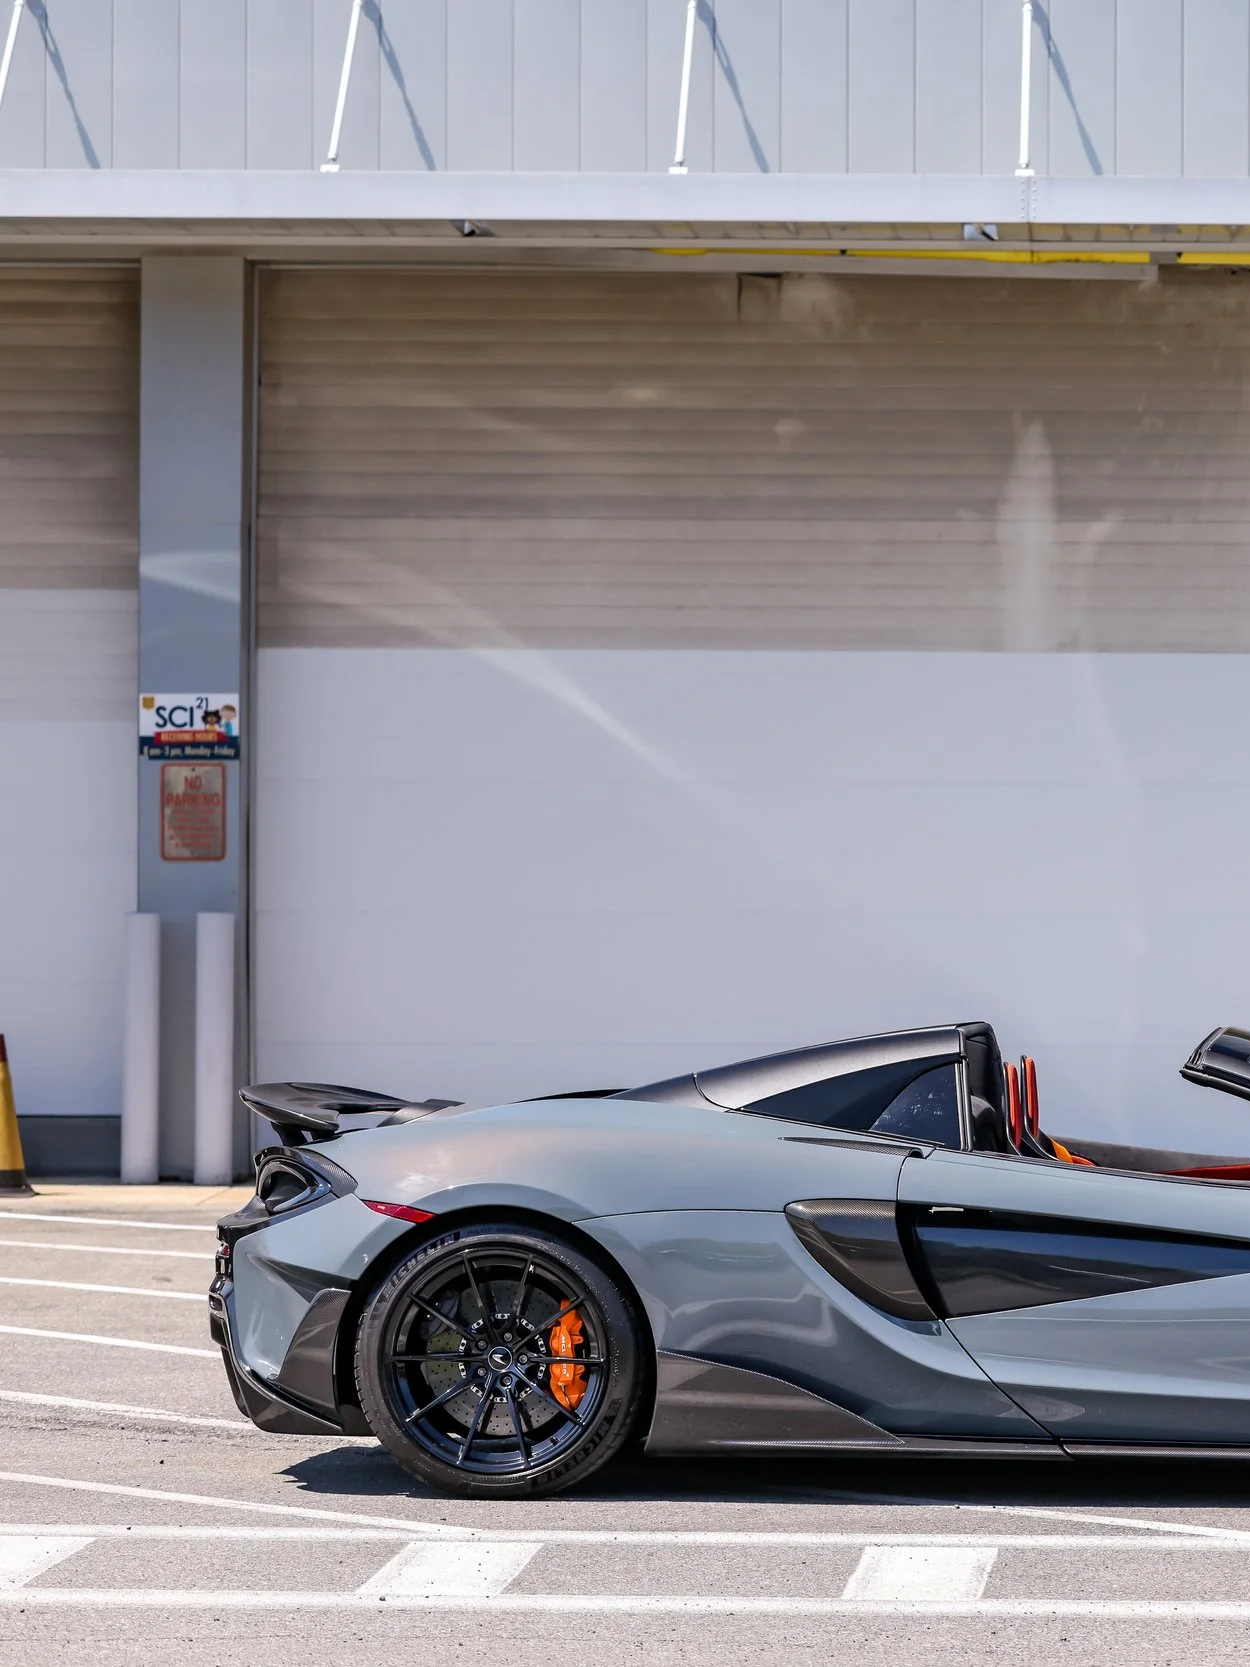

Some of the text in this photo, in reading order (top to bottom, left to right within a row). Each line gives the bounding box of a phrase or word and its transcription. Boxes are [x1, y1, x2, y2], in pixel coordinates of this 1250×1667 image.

[155, 705, 194, 728] SCI
[183, 775, 203, 790] NO
[167, 793, 221, 806] PARKING
